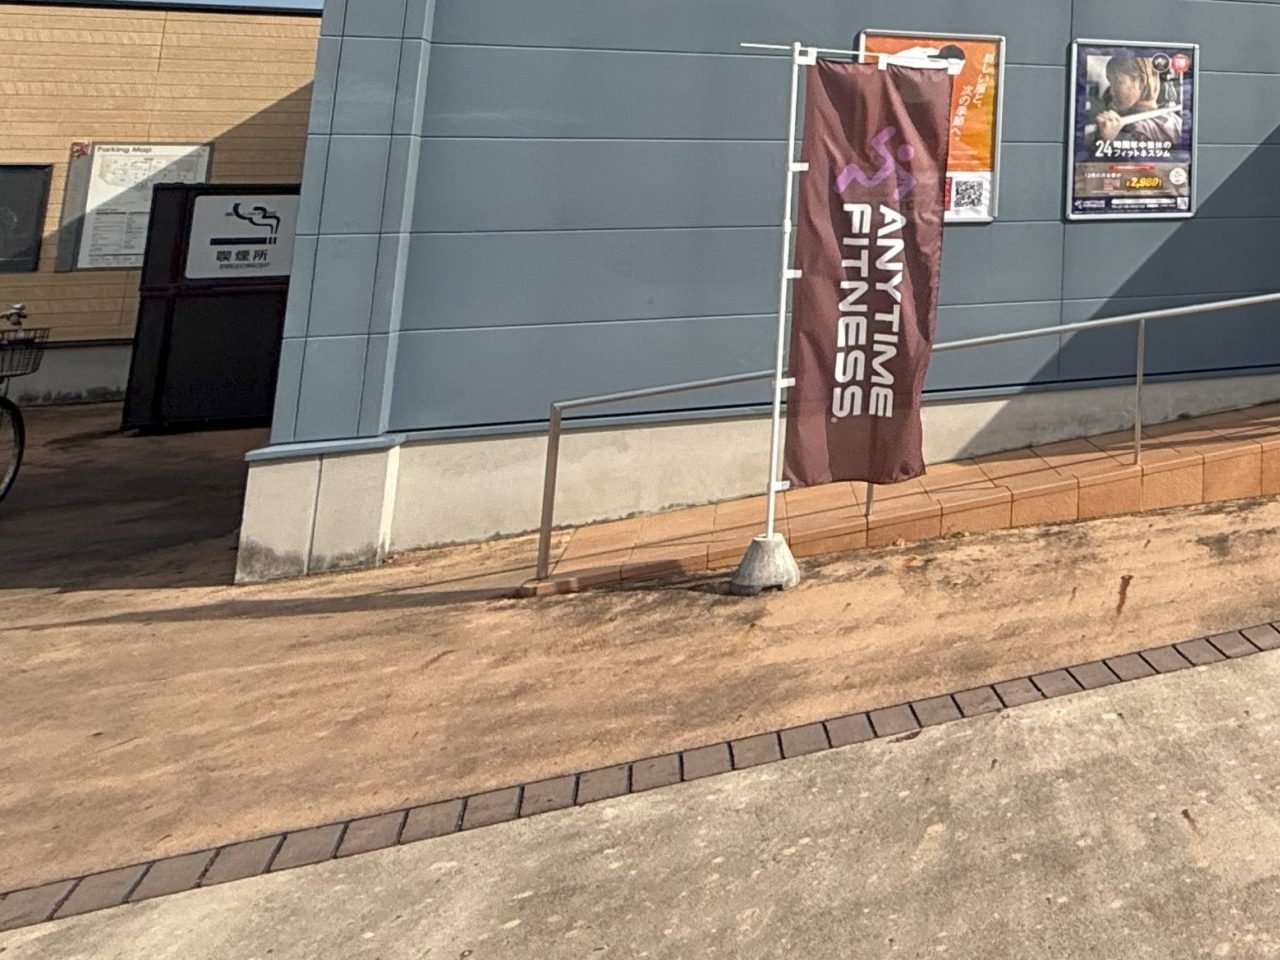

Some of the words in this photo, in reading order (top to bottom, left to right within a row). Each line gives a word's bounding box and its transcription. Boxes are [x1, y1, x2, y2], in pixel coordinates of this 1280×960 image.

[216, 249, 269, 262] 喫煙所
[832, 202, 873, 419] FITNESS
[868, 204, 907, 419] ANYTIME
